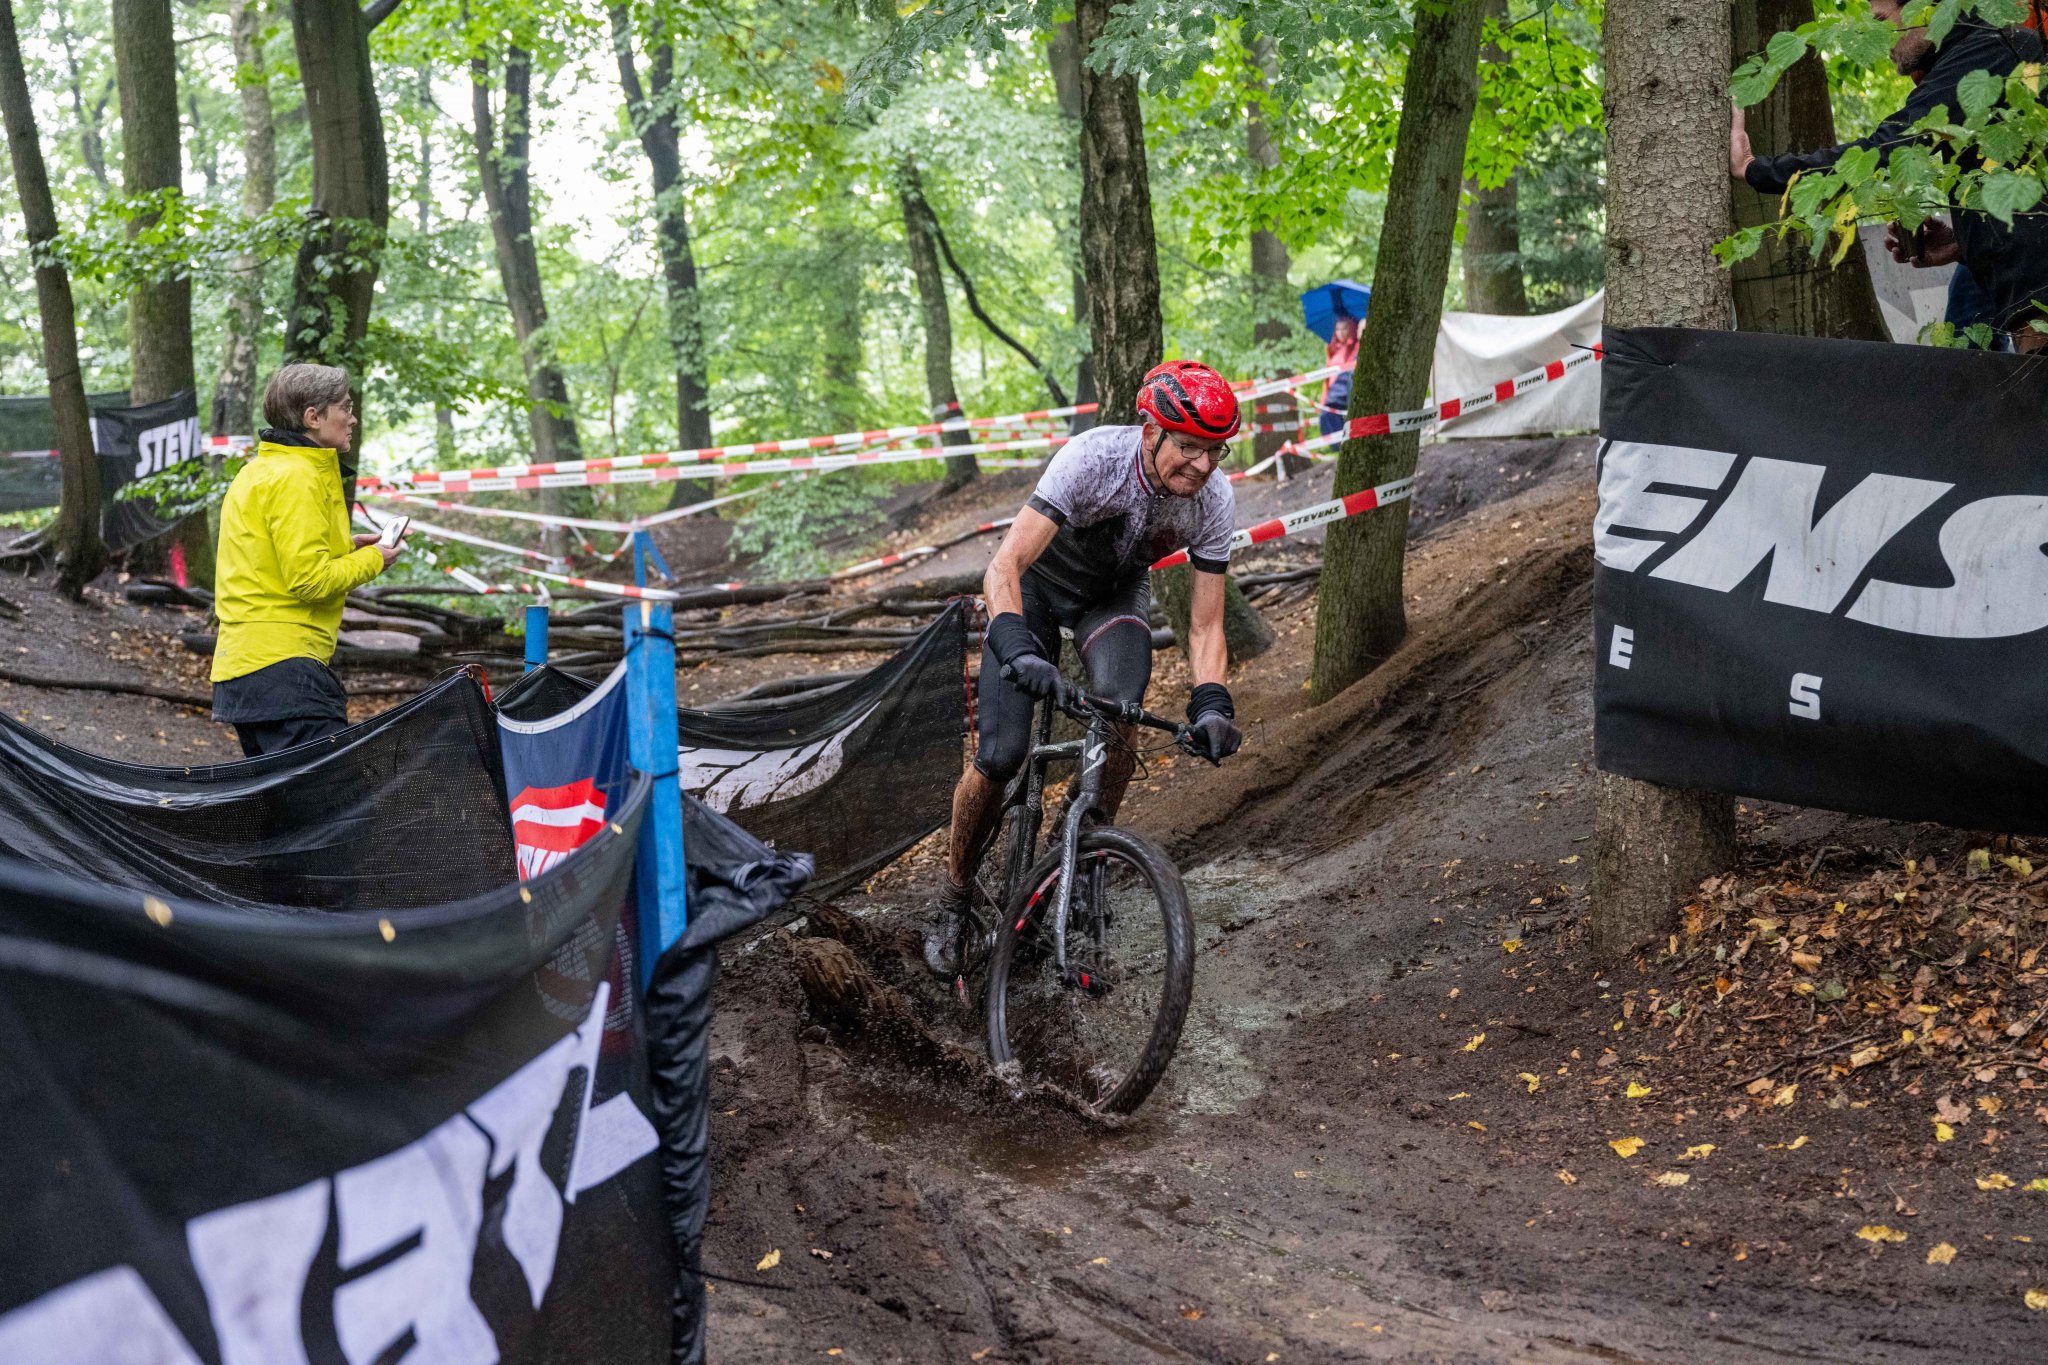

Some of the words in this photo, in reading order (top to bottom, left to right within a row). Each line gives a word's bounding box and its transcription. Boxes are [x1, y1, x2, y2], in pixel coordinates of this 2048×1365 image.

[1395, 410, 1438, 426] STEVENS
[1462, 392, 1494, 409] STEVENS
[1517, 373, 1545, 390] STEVENS
[1566, 352, 1593, 370] STEVENS
[1288, 505, 1340, 527] STEVENS
[1594, 436, 2048, 638] ENS
